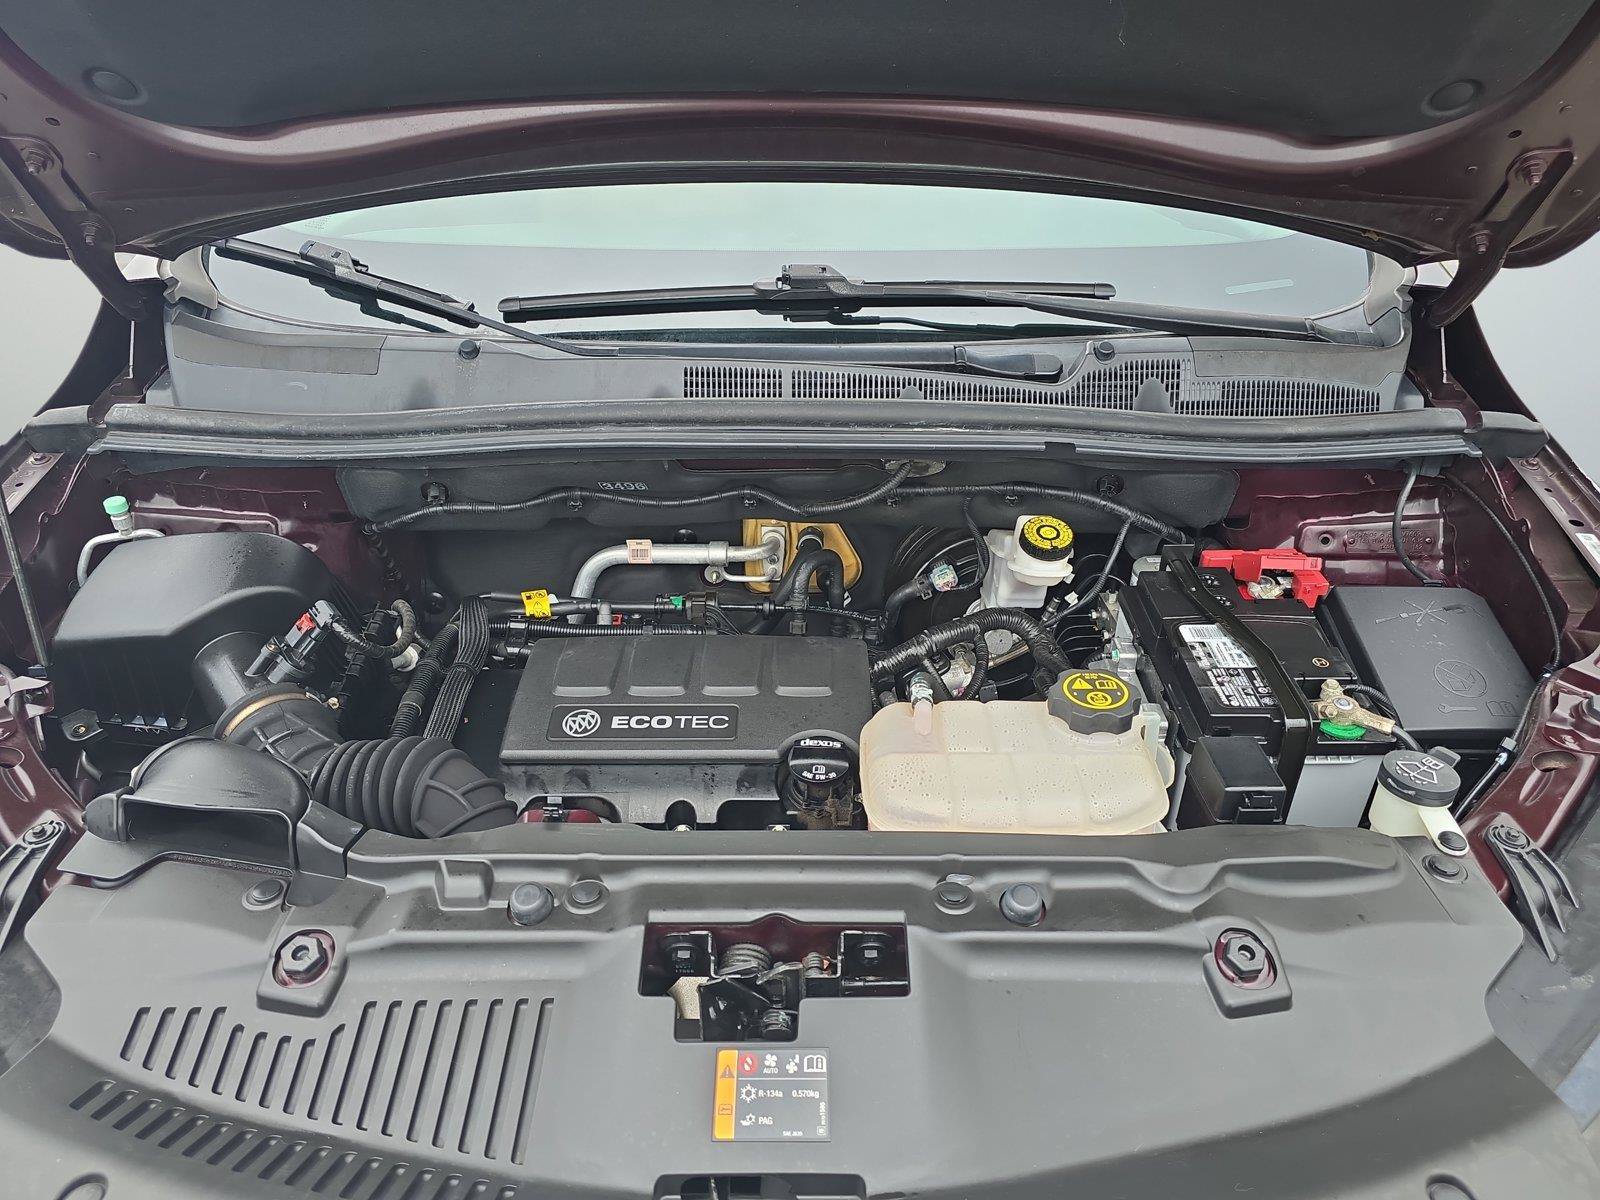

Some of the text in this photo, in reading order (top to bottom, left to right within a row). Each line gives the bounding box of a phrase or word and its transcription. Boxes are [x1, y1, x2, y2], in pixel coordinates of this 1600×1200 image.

[610, 715, 729, 729] ECOTEC
[800, 738, 842, 748] dexos
[802, 771, 837, 780] SAE 5W-30
[758, 1089, 820, 1099] R-134a 0.570kg
[758, 1116, 774, 1125] PAG
